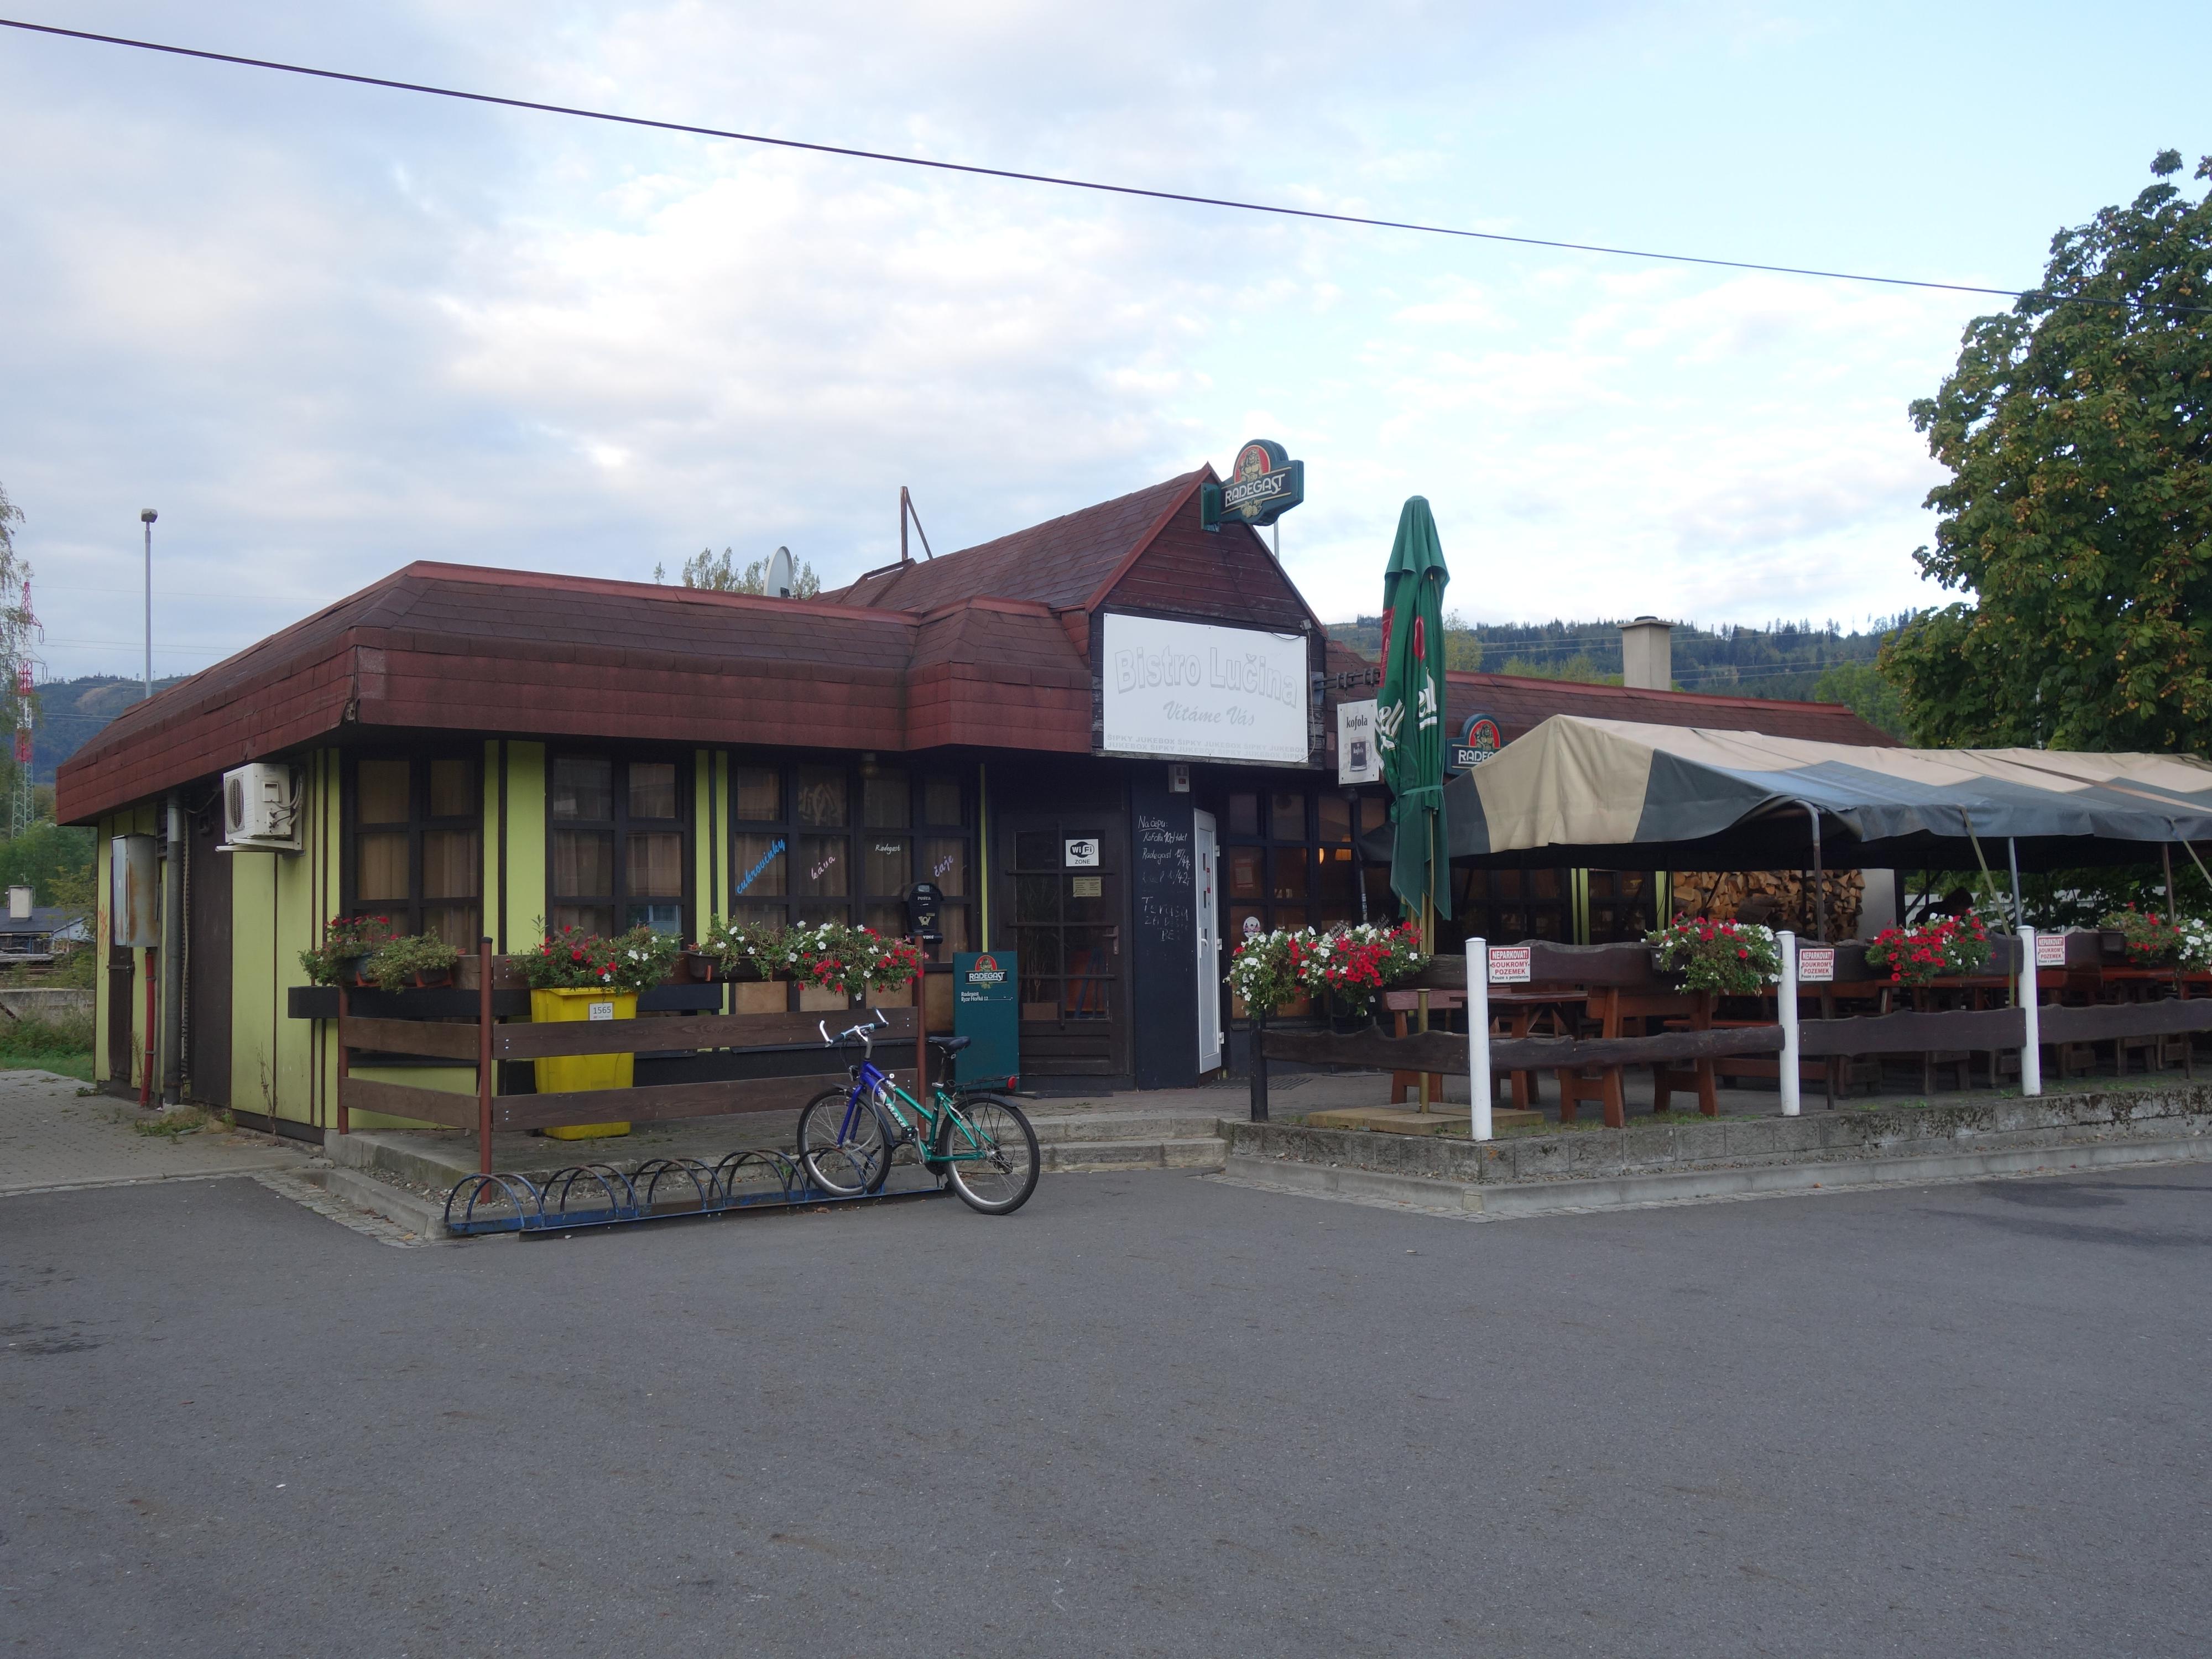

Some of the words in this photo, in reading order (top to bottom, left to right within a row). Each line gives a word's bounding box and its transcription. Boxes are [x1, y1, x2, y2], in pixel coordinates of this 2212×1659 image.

[1224, 473, 1285, 508] RADEGAST
[1115, 644, 1201, 695] Bistro
[1210, 646, 1297, 709] Lučina
[1163, 700, 1222, 723] Vítáme
[1226, 706, 1255, 726] Vás
[1346, 714, 1368, 731] kofola
[1107, 742, 1148, 750] JUKEBOX
[1135, 737, 1176, 745] JUKEBOX
[1138, 815, 1150, 828] Na
[875, 843, 901, 855] Radegast
[736, 839, 785, 894] cukrovinky
[811, 856, 836, 880] káva
[933, 855, 954, 877] čaje
[1492, 950, 1528, 959] NEPARKOVAT!
[1803, 951, 1832, 959] NEPARKOVAT!
[969, 972, 1005, 982] RADEGAST
